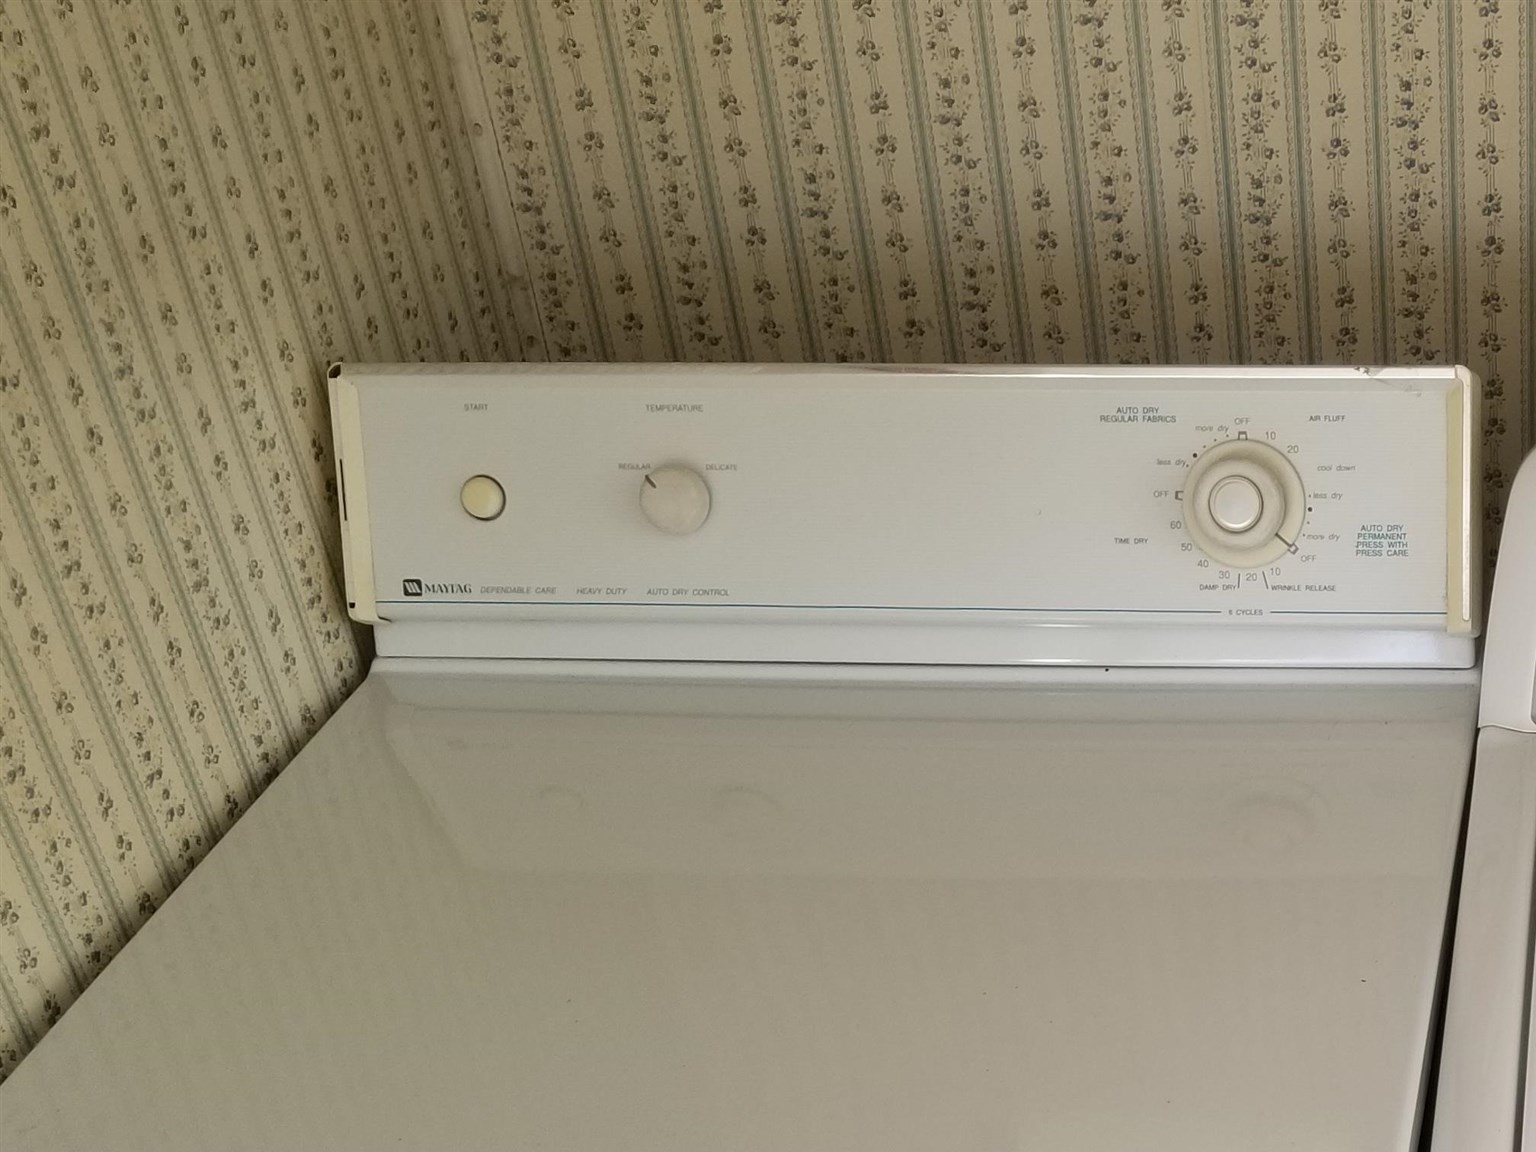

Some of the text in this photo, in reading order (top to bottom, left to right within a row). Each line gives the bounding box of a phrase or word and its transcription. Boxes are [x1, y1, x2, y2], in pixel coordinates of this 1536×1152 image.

[464, 403, 488, 412] START
[645, 404, 704, 412] TEMPERATURE
[1100, 415, 1177, 423] REGULAR FABRICS
[1217, 424, 1230, 433] dry
[1265, 431, 1276, 440] 10
[1287, 445, 1299, 454] 20
[618, 463, 651, 471] REGULAR
[705, 463, 738, 471] DELICATE
[1156, 458, 1187, 468] less dry
[1317, 464, 1356, 472] cool down
[1331, 492, 1343, 501] dry
[1170, 521, 1182, 529] 60
[1328, 533, 1341, 542] dry
[1181, 543, 1193, 551] 50
[1357, 541, 1408, 549] PRESS WITH
[1355, 549, 1383, 557] PRESS
[1197, 560, 1209, 568] 40
[1218, 571, 1230, 579] 30
[1270, 567, 1281, 576] 10
[1245, 573, 1257, 581] 20
[424, 583, 472, 594] MAYTAG
[480, 586, 557, 595] DEPENDABLE CARE
[576, 587, 628, 595] HEAVY DUTY
[646, 588, 730, 597] AUTO DRY CONTROL
